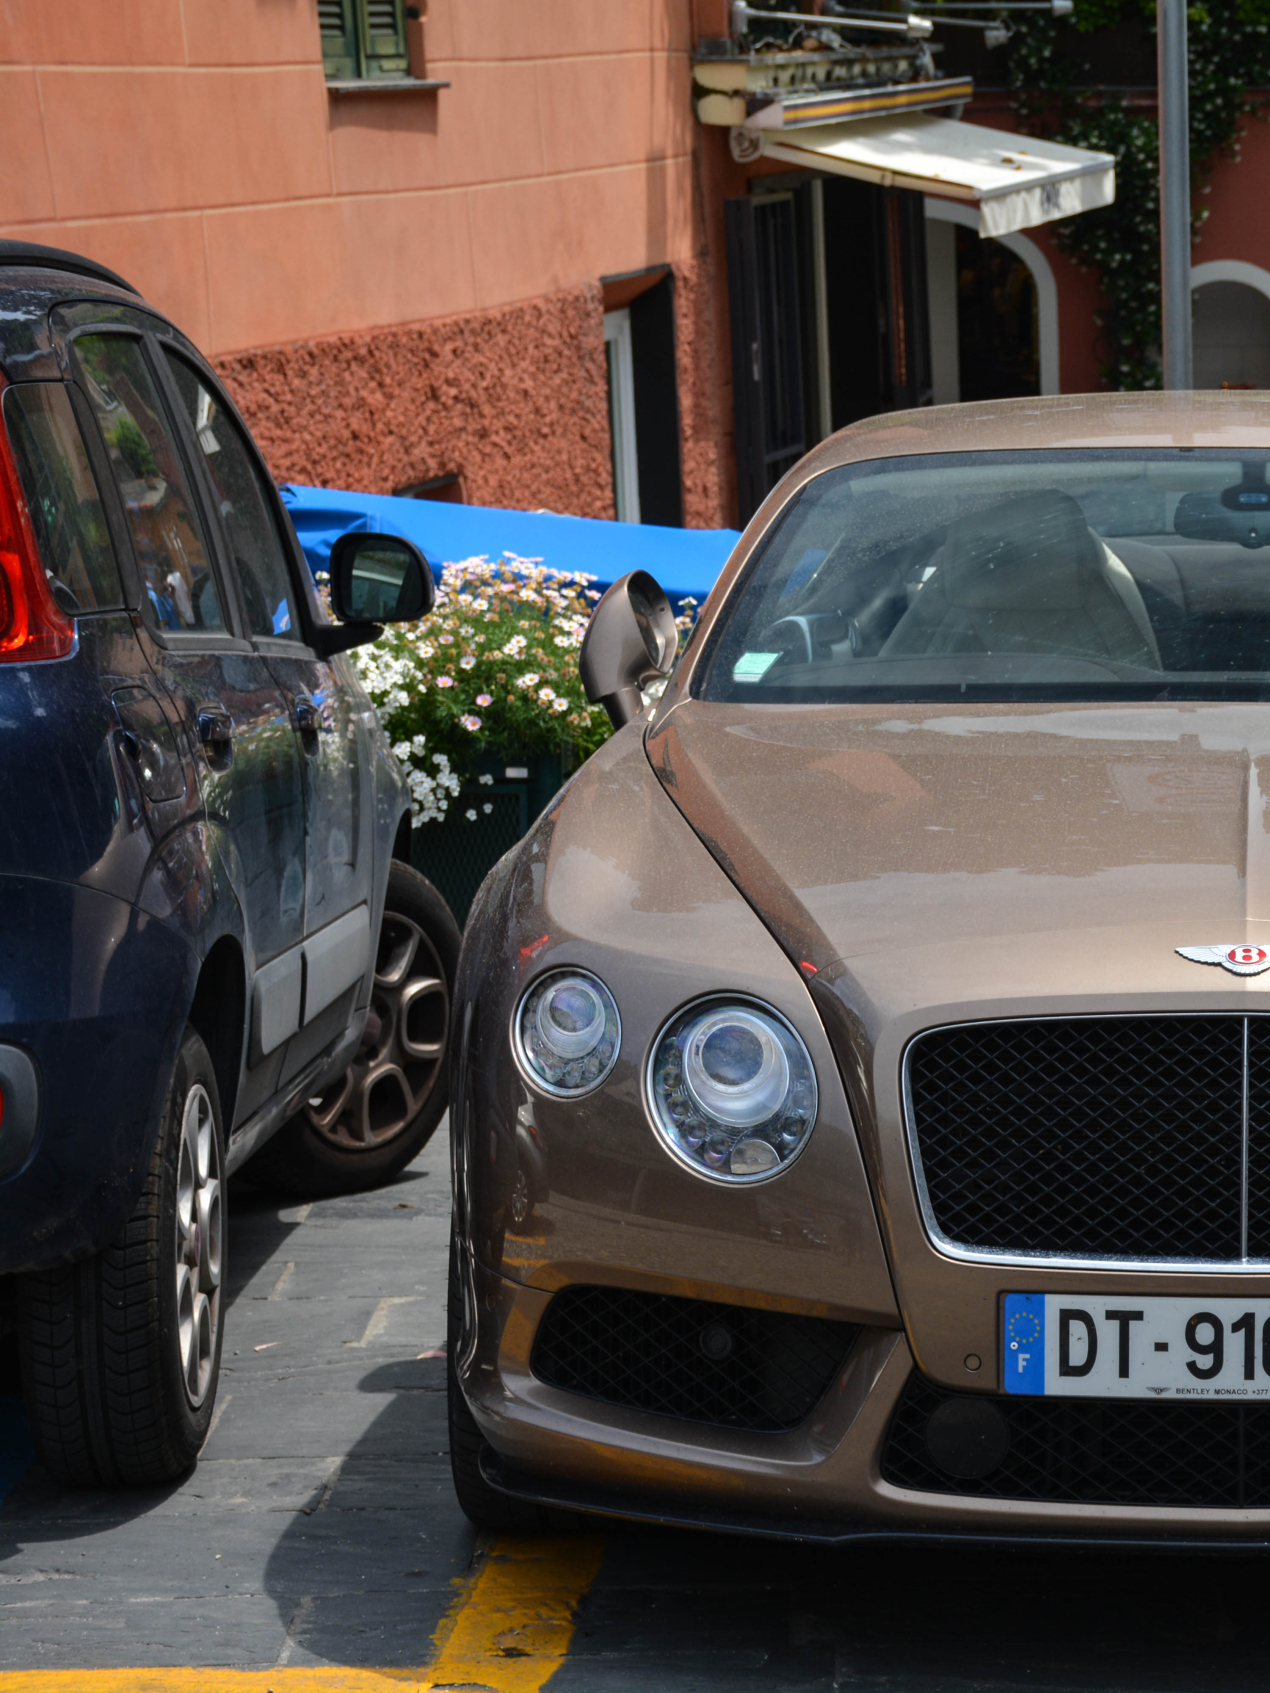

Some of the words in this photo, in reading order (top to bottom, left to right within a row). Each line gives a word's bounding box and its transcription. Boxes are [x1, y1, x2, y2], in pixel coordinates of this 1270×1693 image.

[1234, 947, 1260, 962] B
[1017, 1353, 1030, 1374] F
[1175, 1387, 1211, 1396] BENTLEY
[1213, 1387, 1248, 1396] MONACO
[1251, 1388, 1269, 1396] +377
